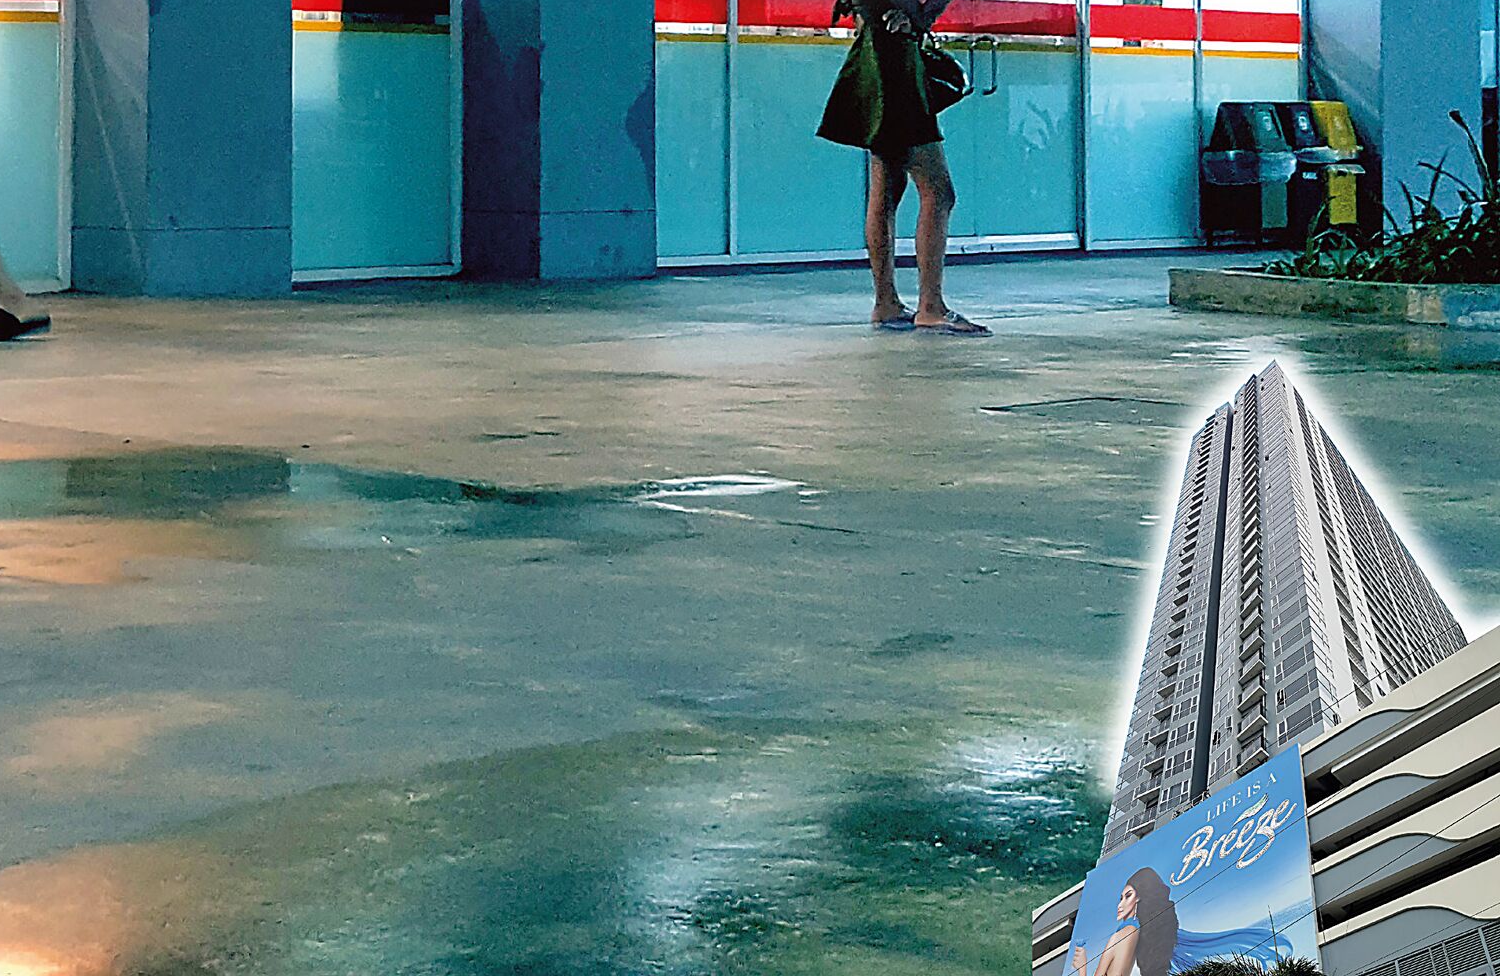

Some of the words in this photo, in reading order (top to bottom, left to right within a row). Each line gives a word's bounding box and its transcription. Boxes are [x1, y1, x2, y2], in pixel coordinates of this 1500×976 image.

[1206, 792, 1242, 822] LIFE
[1247, 781, 1261, 798] IS
[1266, 773, 1277, 787] A
[1170, 798, 1297, 885] Breeze
